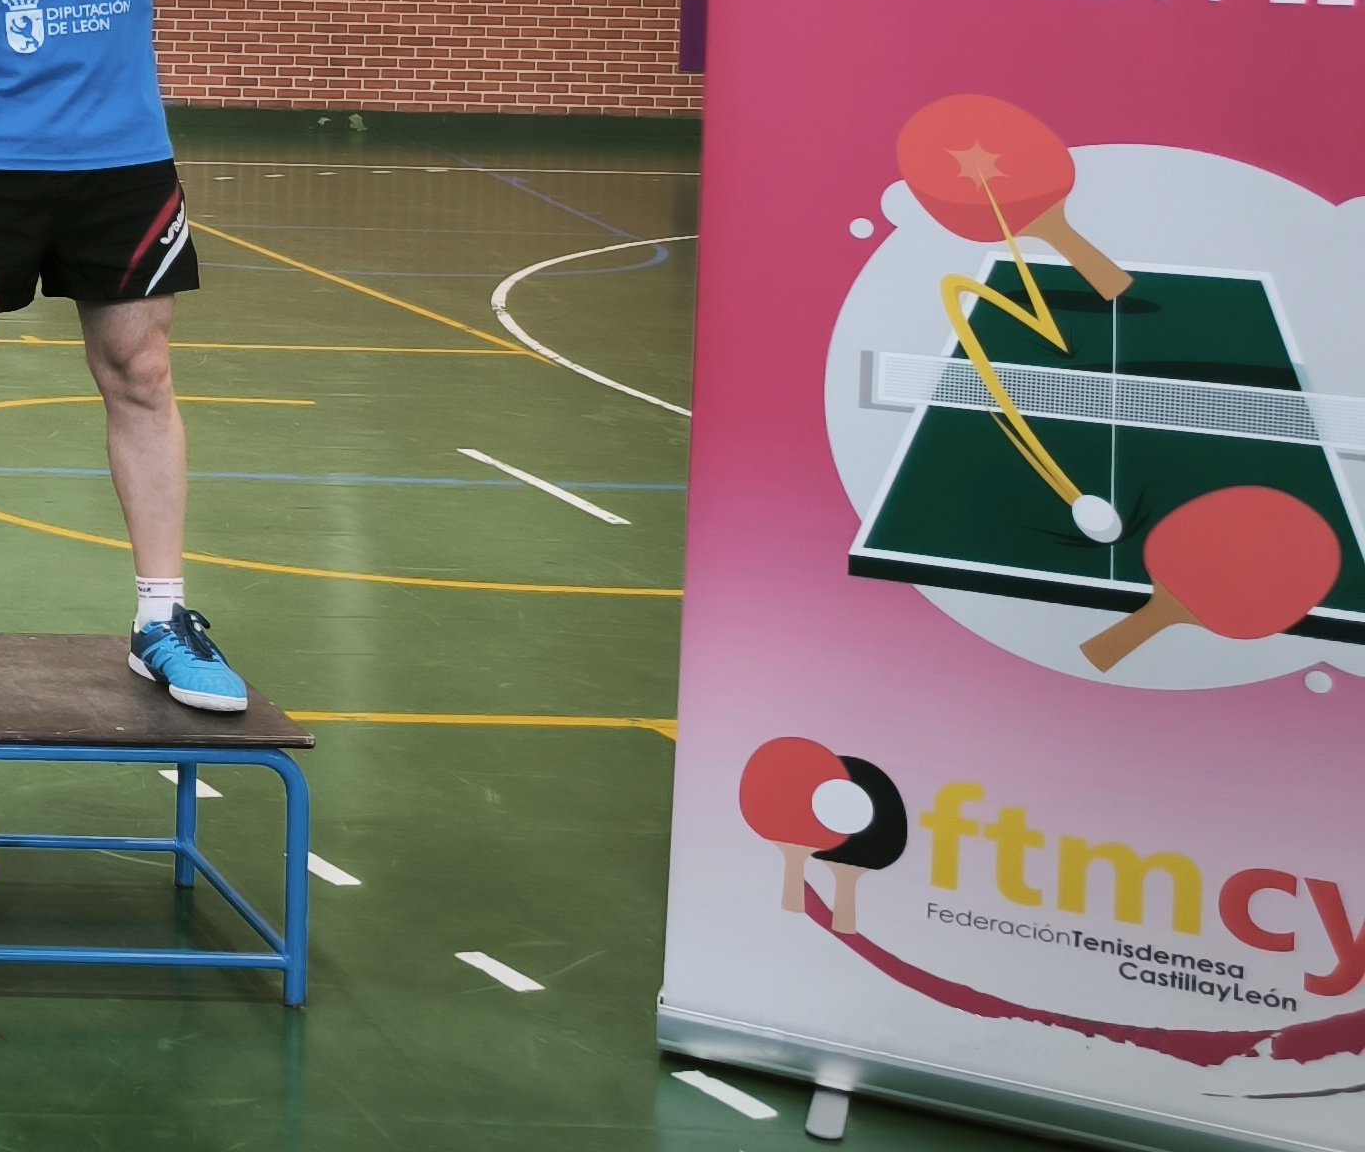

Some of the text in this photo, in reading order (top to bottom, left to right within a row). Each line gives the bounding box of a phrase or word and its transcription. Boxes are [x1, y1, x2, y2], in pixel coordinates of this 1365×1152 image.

[47, 15, 110, 36] DE LEÓN
[919, 779, 1365, 997] ftmcy
[1118, 961, 1298, 1012] CastillayLeón
